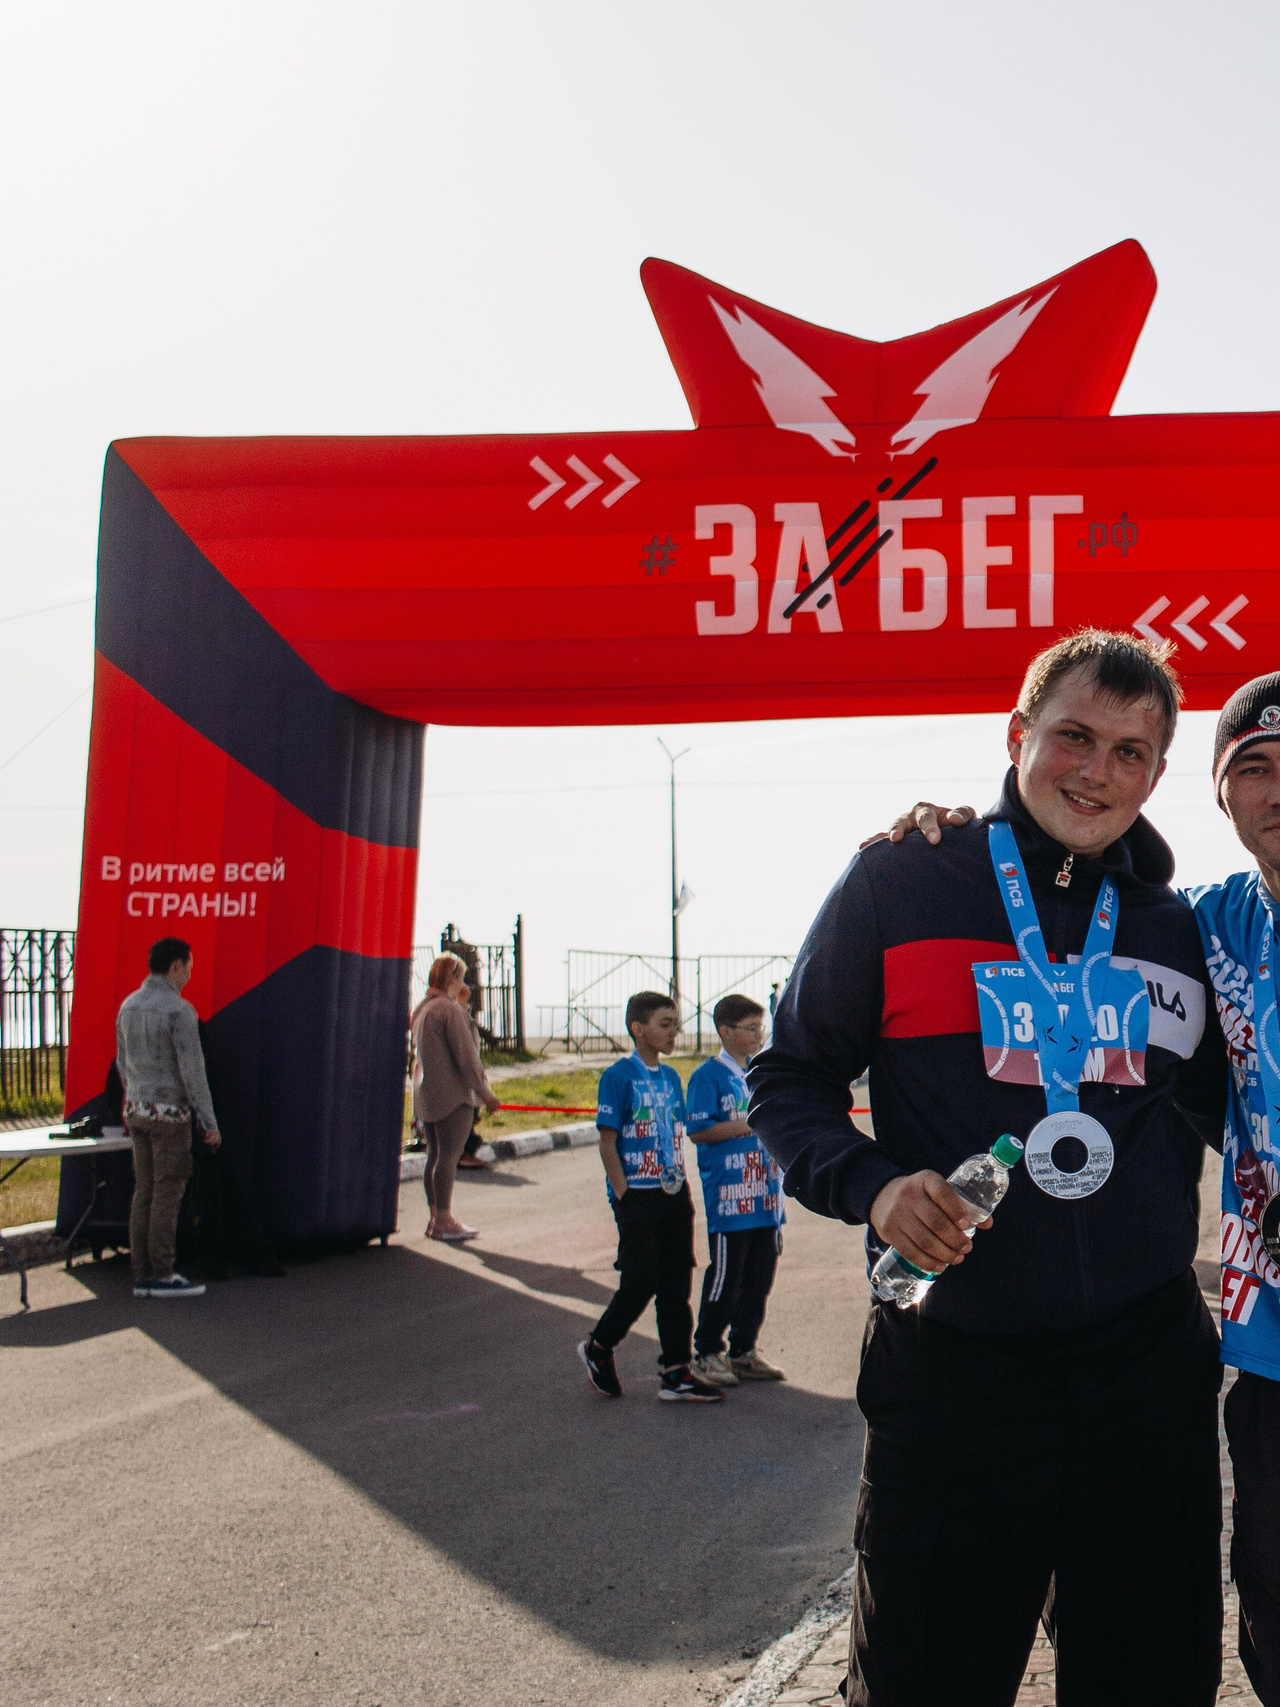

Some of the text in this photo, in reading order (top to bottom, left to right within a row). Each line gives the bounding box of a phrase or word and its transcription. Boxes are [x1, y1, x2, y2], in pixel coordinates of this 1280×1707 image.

[101, 855, 286, 886] В ритме всей
[127, 892, 257, 918] СТРАНЫ!
[1005, 879, 1024, 908] ПСБ
[1102, 885, 1115, 913] ПСБ
[1001, 967, 1026, 978] ПСБ
[725, 1151, 763, 1170] #ЗАБЕГ
[719, 1181, 769, 1201] #ЛЮБОВЬ
[718, 1198, 755, 1216] #ЗАБЕГ
